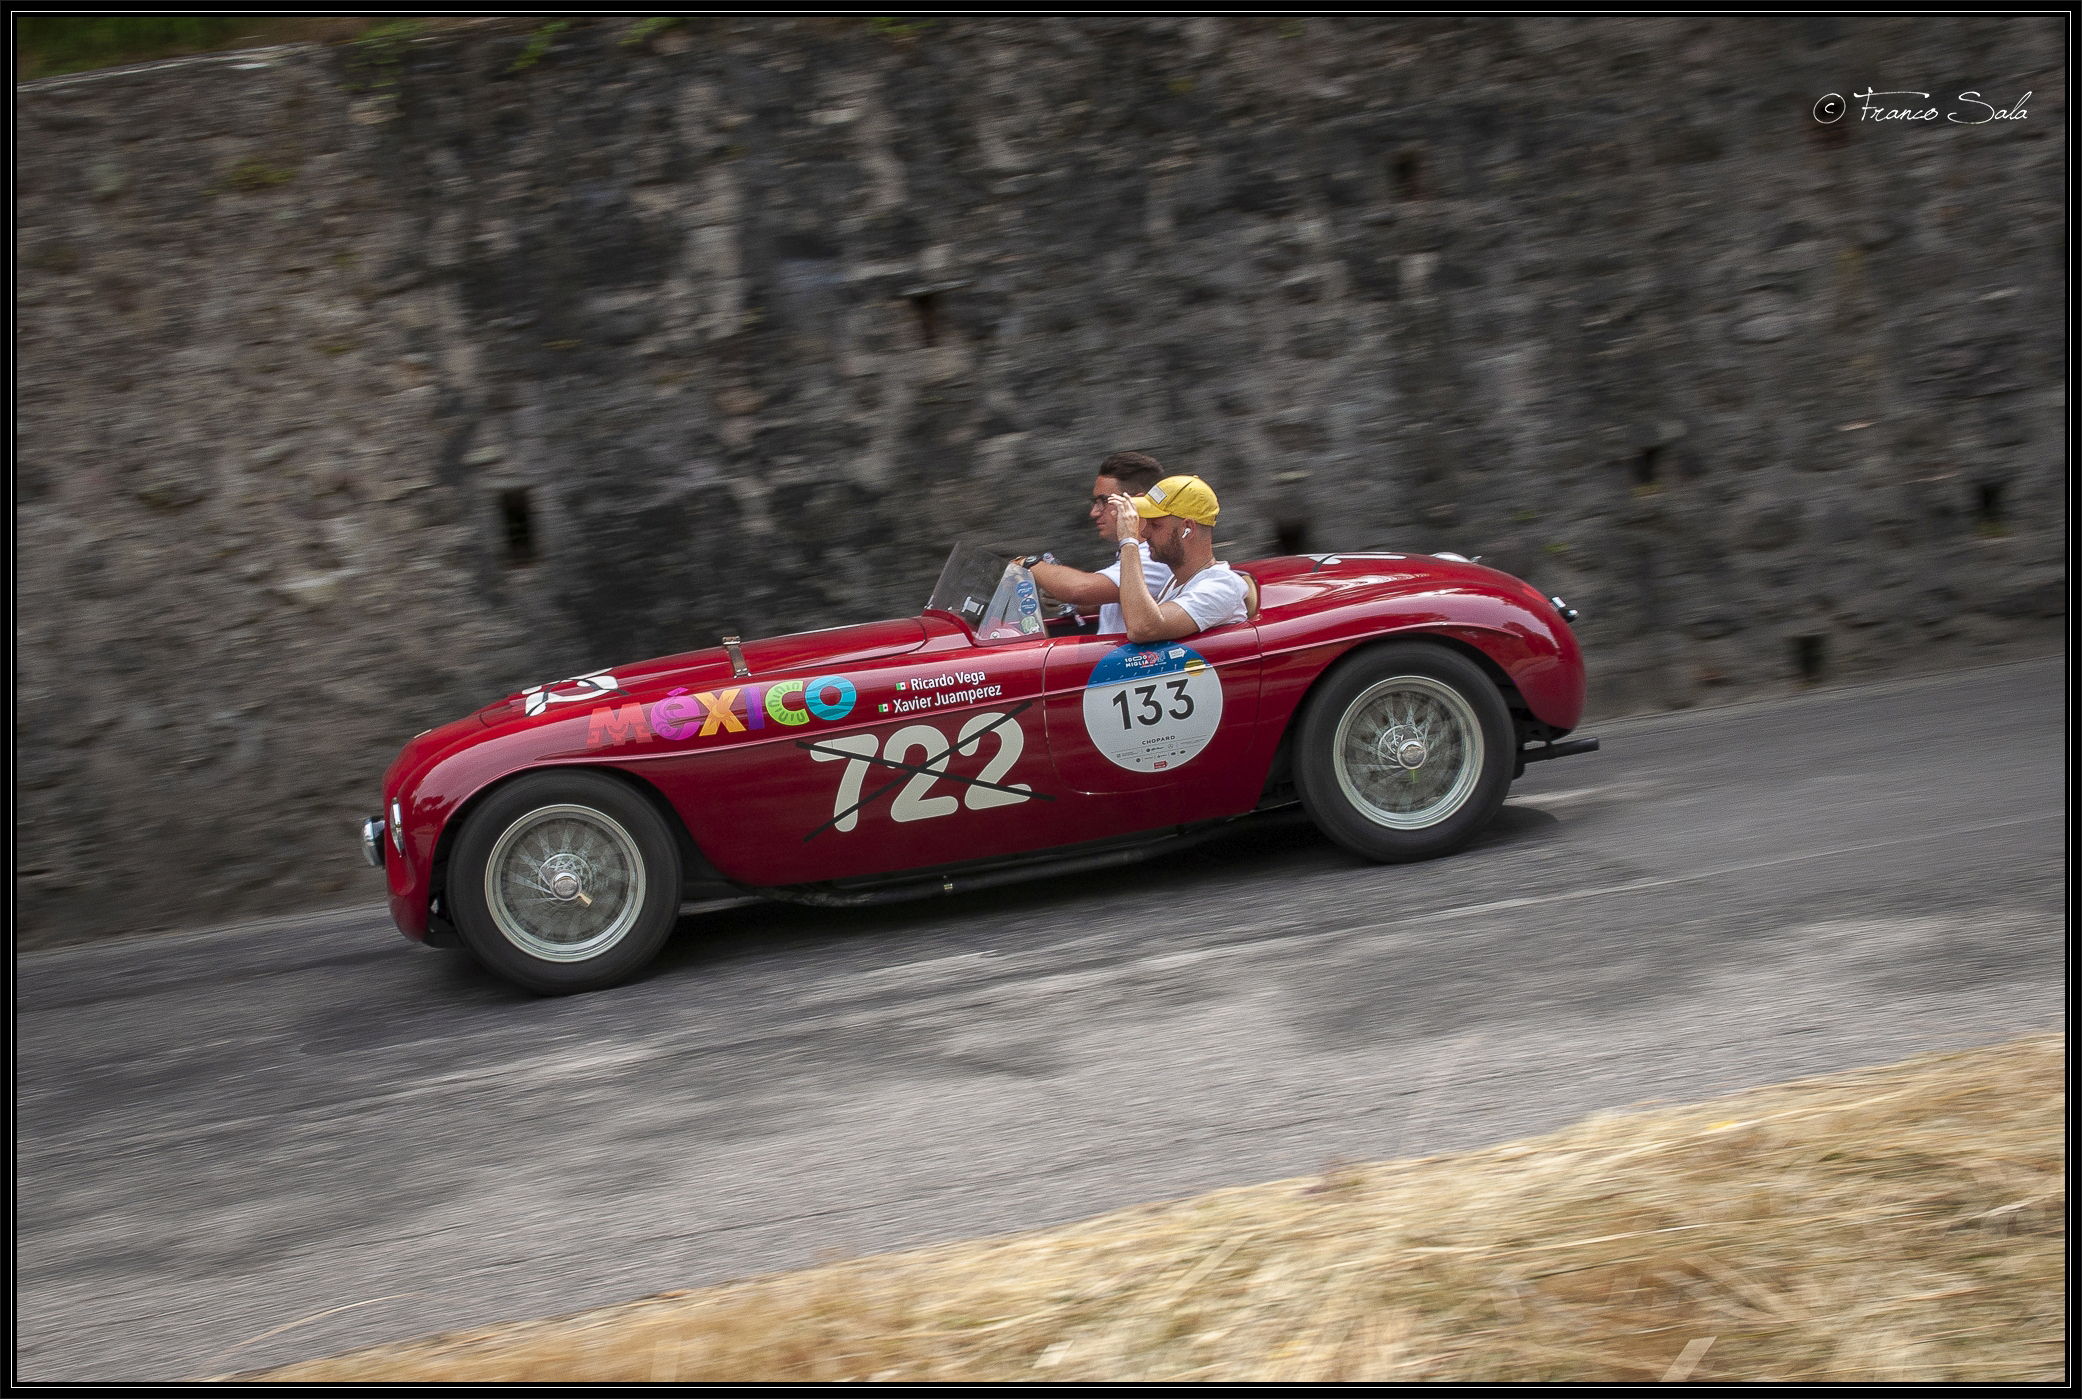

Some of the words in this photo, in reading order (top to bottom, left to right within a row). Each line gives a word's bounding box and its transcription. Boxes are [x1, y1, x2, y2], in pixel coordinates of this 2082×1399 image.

[1125, 659, 1150, 669] MIGLIA
[910, 673, 955, 691] Ricardo
[955, 671, 986, 686] Vega
[893, 695, 932, 714] Xavier
[934, 684, 1003, 704] Juamperez
[1112, 678, 1195, 730] 133
[1141, 735, 1176, 745] CHOPARD
[809, 712, 1033, 833] 722
